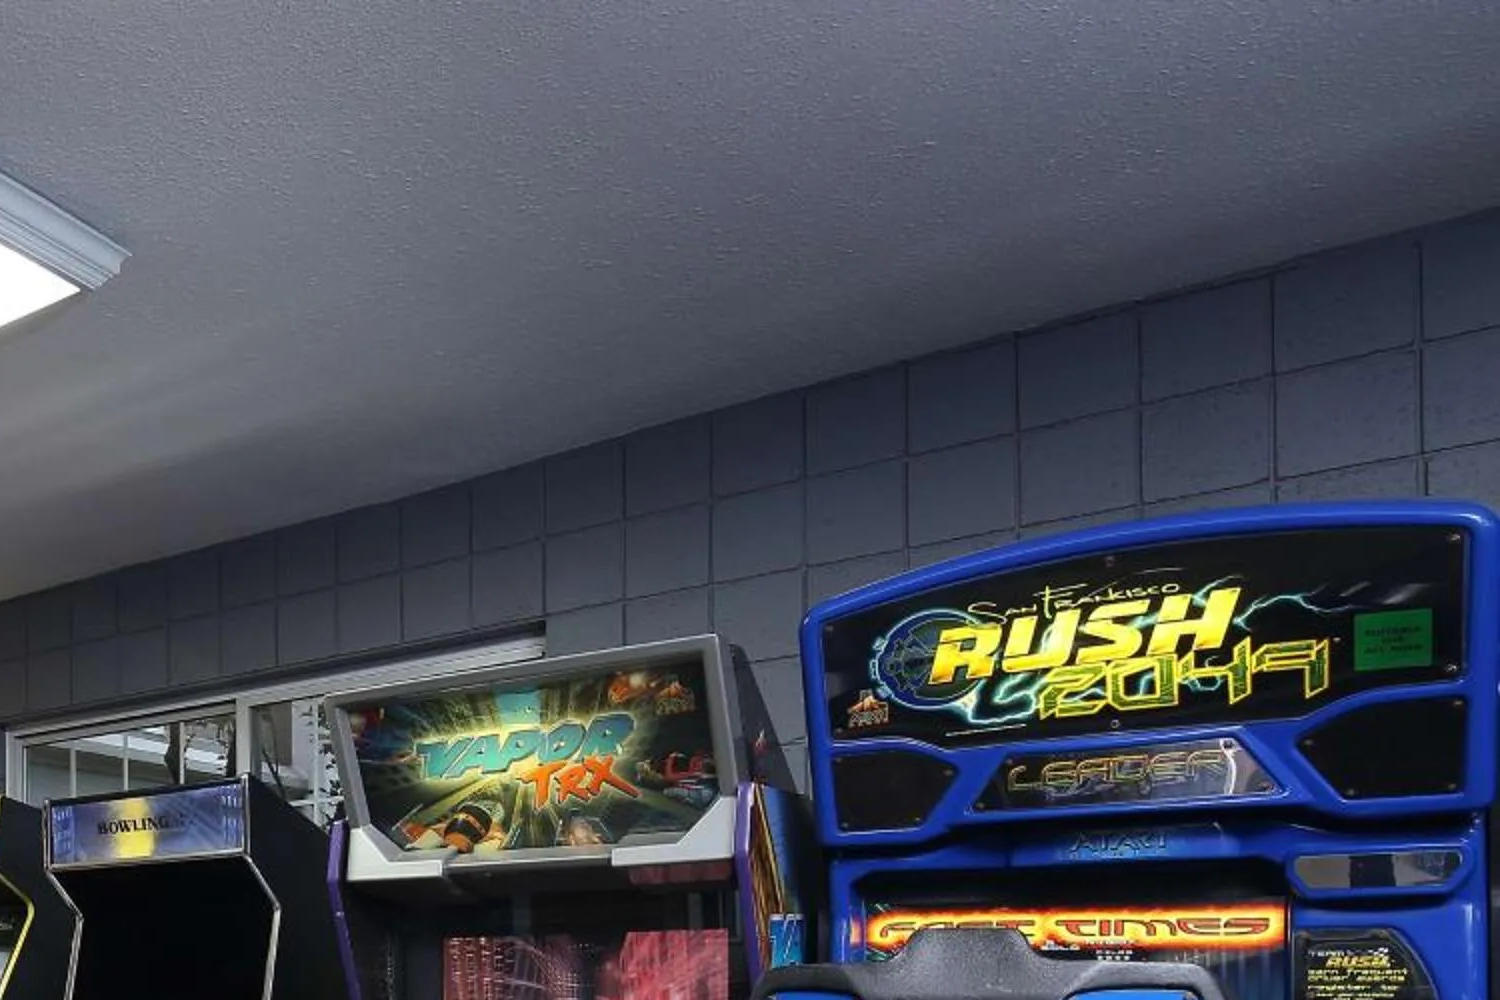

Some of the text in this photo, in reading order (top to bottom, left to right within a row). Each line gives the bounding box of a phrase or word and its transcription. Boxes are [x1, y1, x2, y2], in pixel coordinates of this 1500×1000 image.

[928, 586, 1241, 685] RUSH
[1039, 636, 1332, 720] 2049
[414, 711, 638, 779] VAPOR
[1007, 749, 1228, 791] LEADER
[521, 755, 643, 809] TRX
[97, 816, 170, 834] BOWLING
[1055, 917, 1271, 937] TIMES
